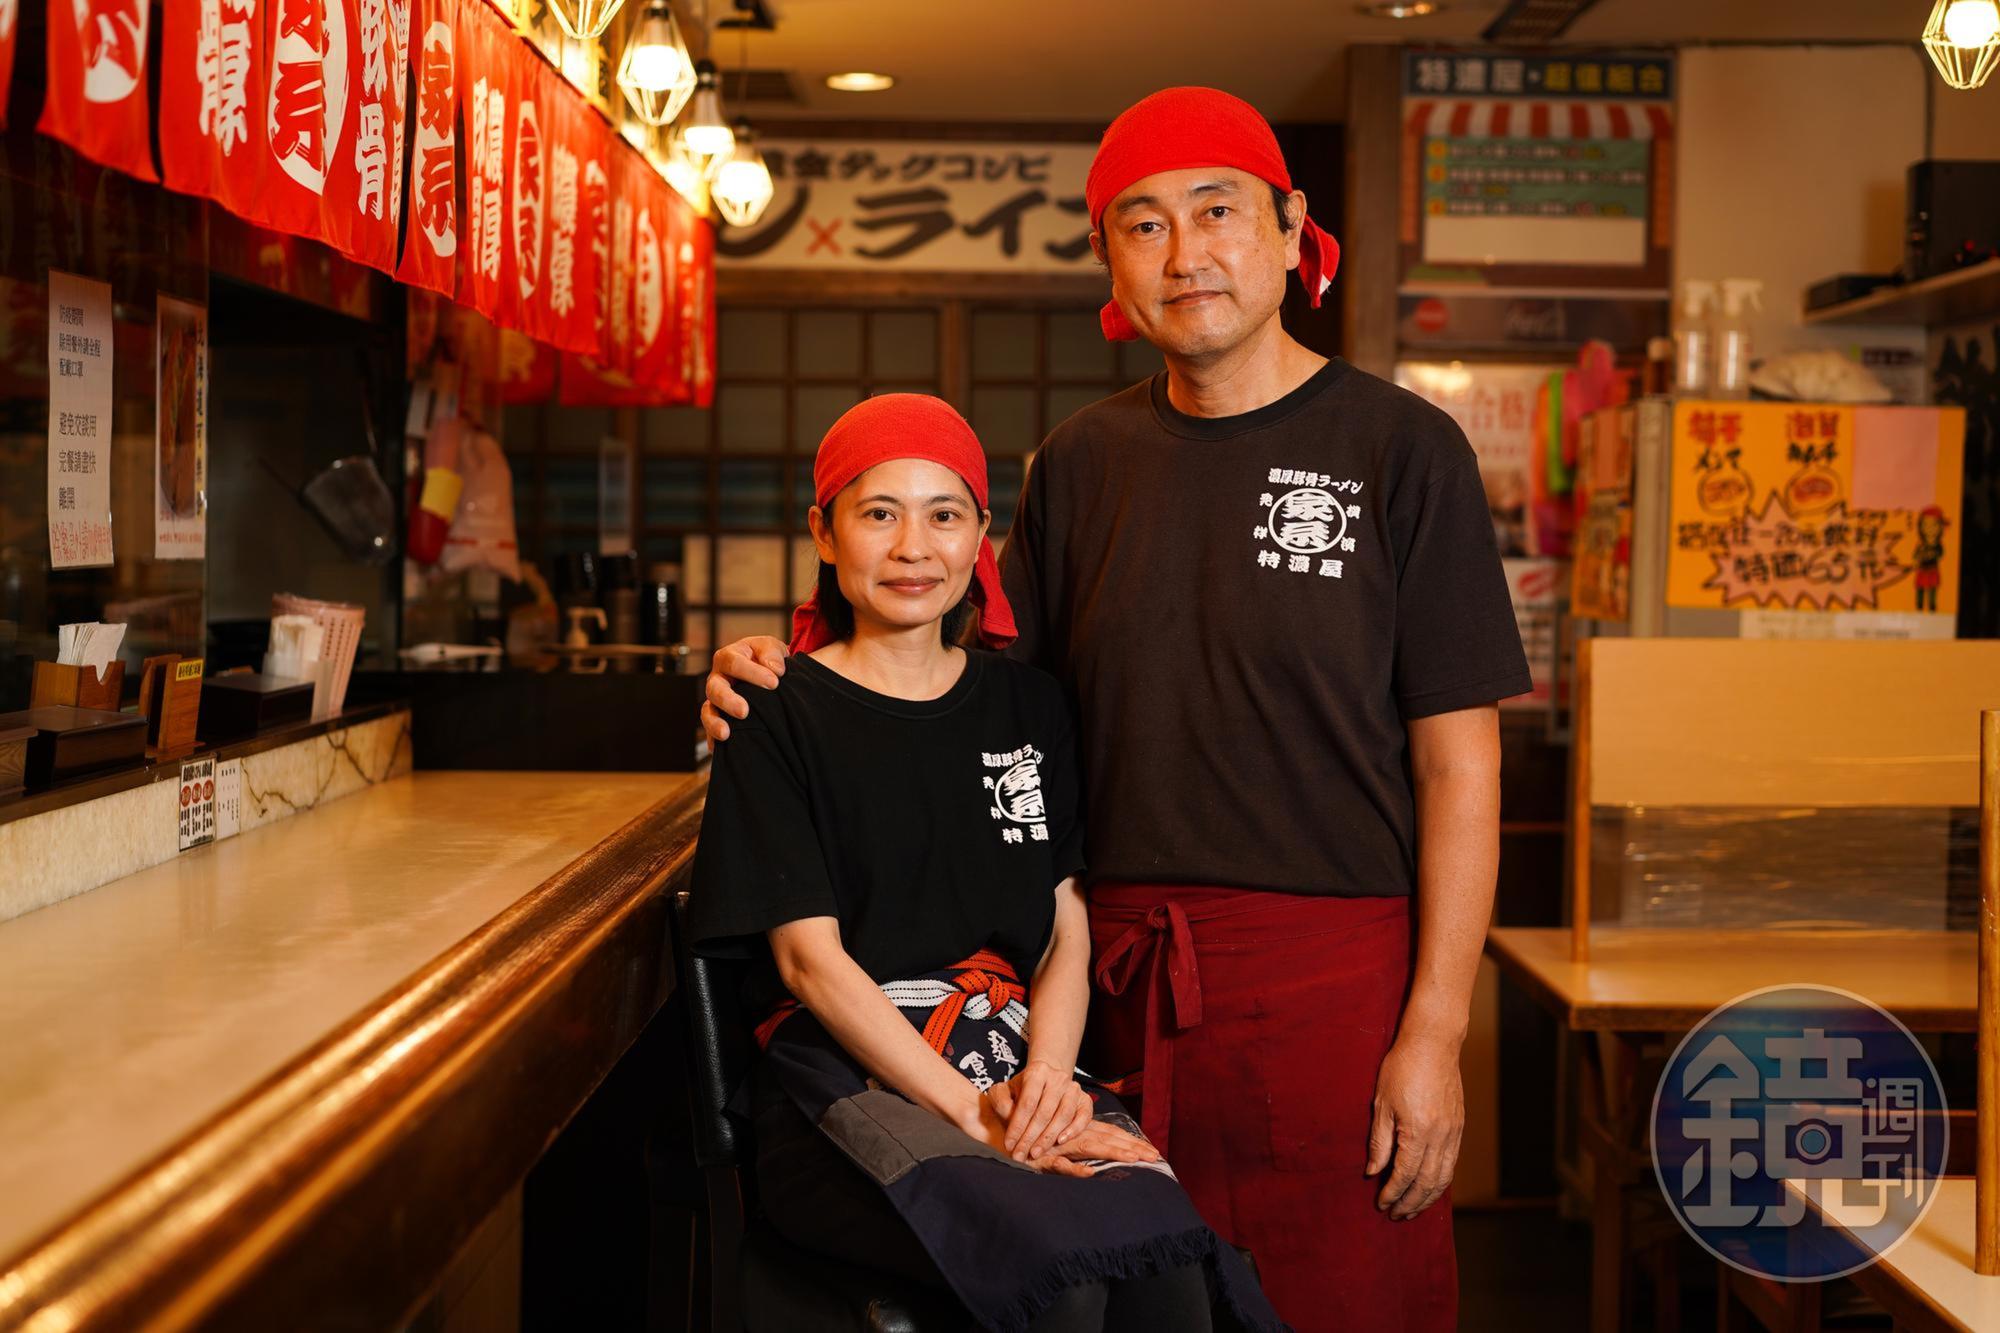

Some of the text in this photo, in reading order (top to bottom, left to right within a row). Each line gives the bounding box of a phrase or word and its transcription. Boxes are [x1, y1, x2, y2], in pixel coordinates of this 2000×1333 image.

[1267, 467, 1364, 495] 濃厚豚骨ラーメン
[1257, 549, 1344, 579] 特濃屋
